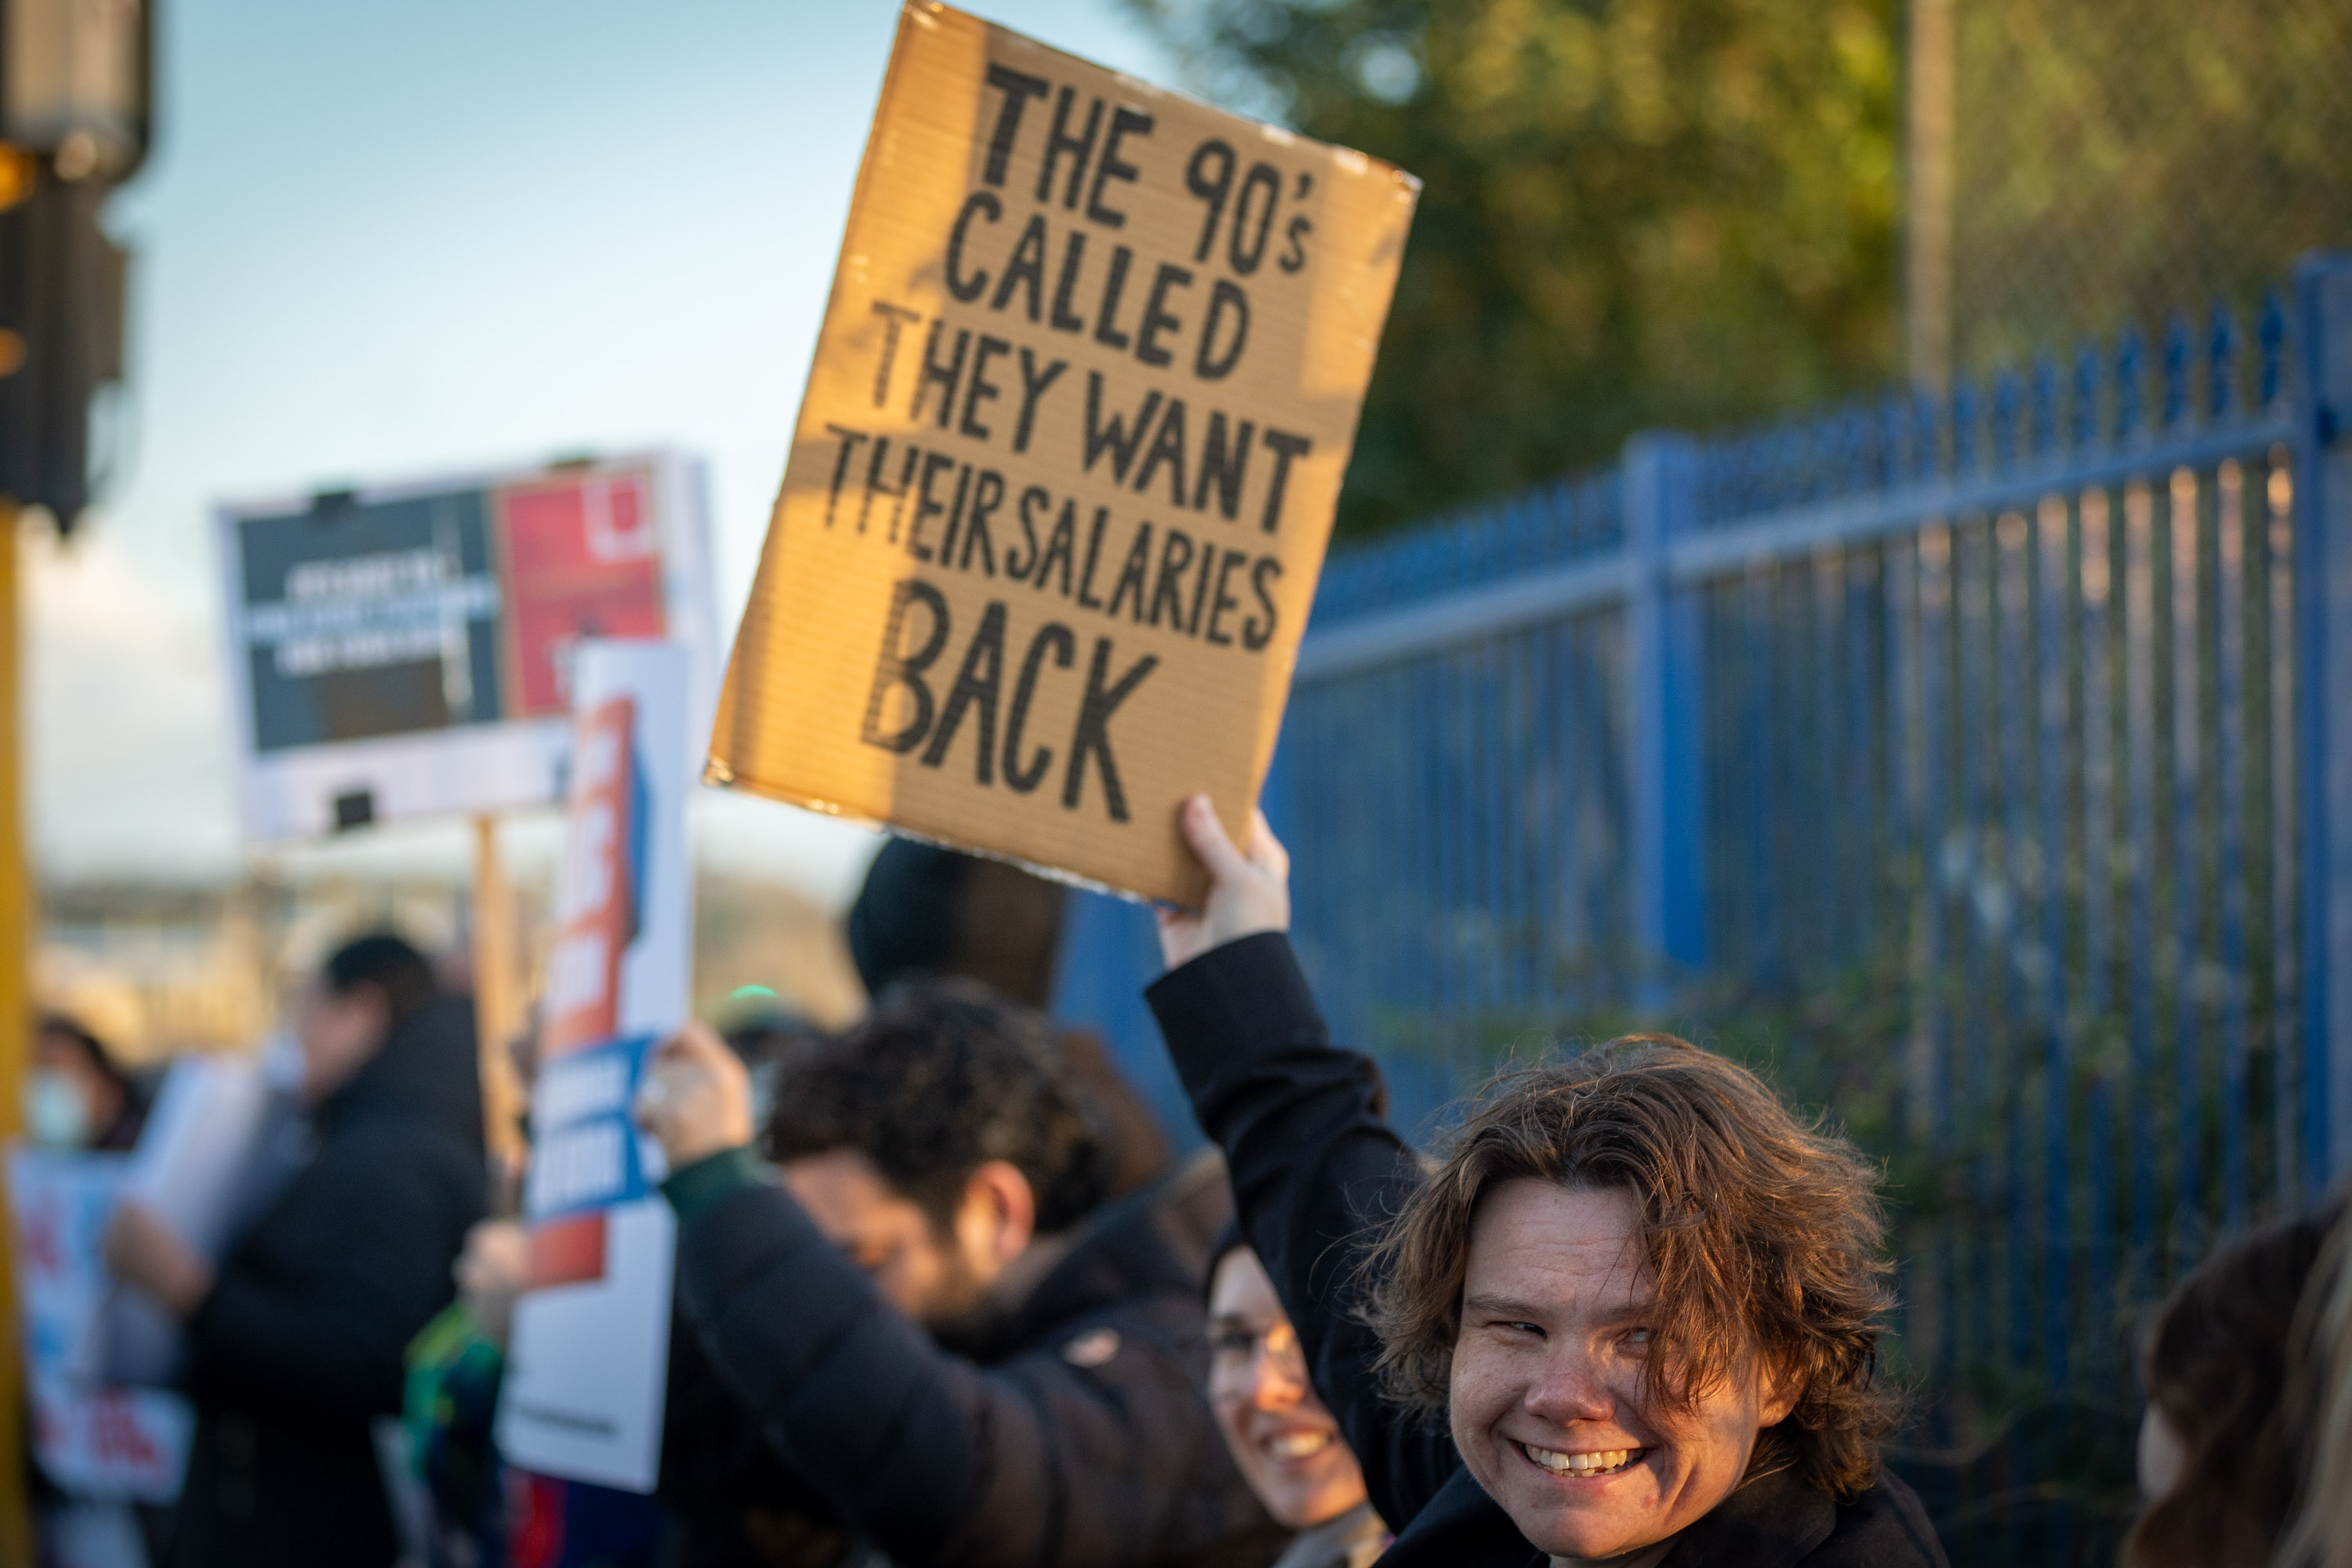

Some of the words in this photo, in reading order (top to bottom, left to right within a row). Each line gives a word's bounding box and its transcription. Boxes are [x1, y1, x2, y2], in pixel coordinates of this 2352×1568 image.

[984, 64, 1155, 228] THE
[1186, 140, 1315, 275] 90's
[946, 191, 1248, 378] CALLED
[870, 301, 1068, 453] THEY
[1084, 372, 1312, 534] WANT
[862, 580, 1159, 823] BACK
